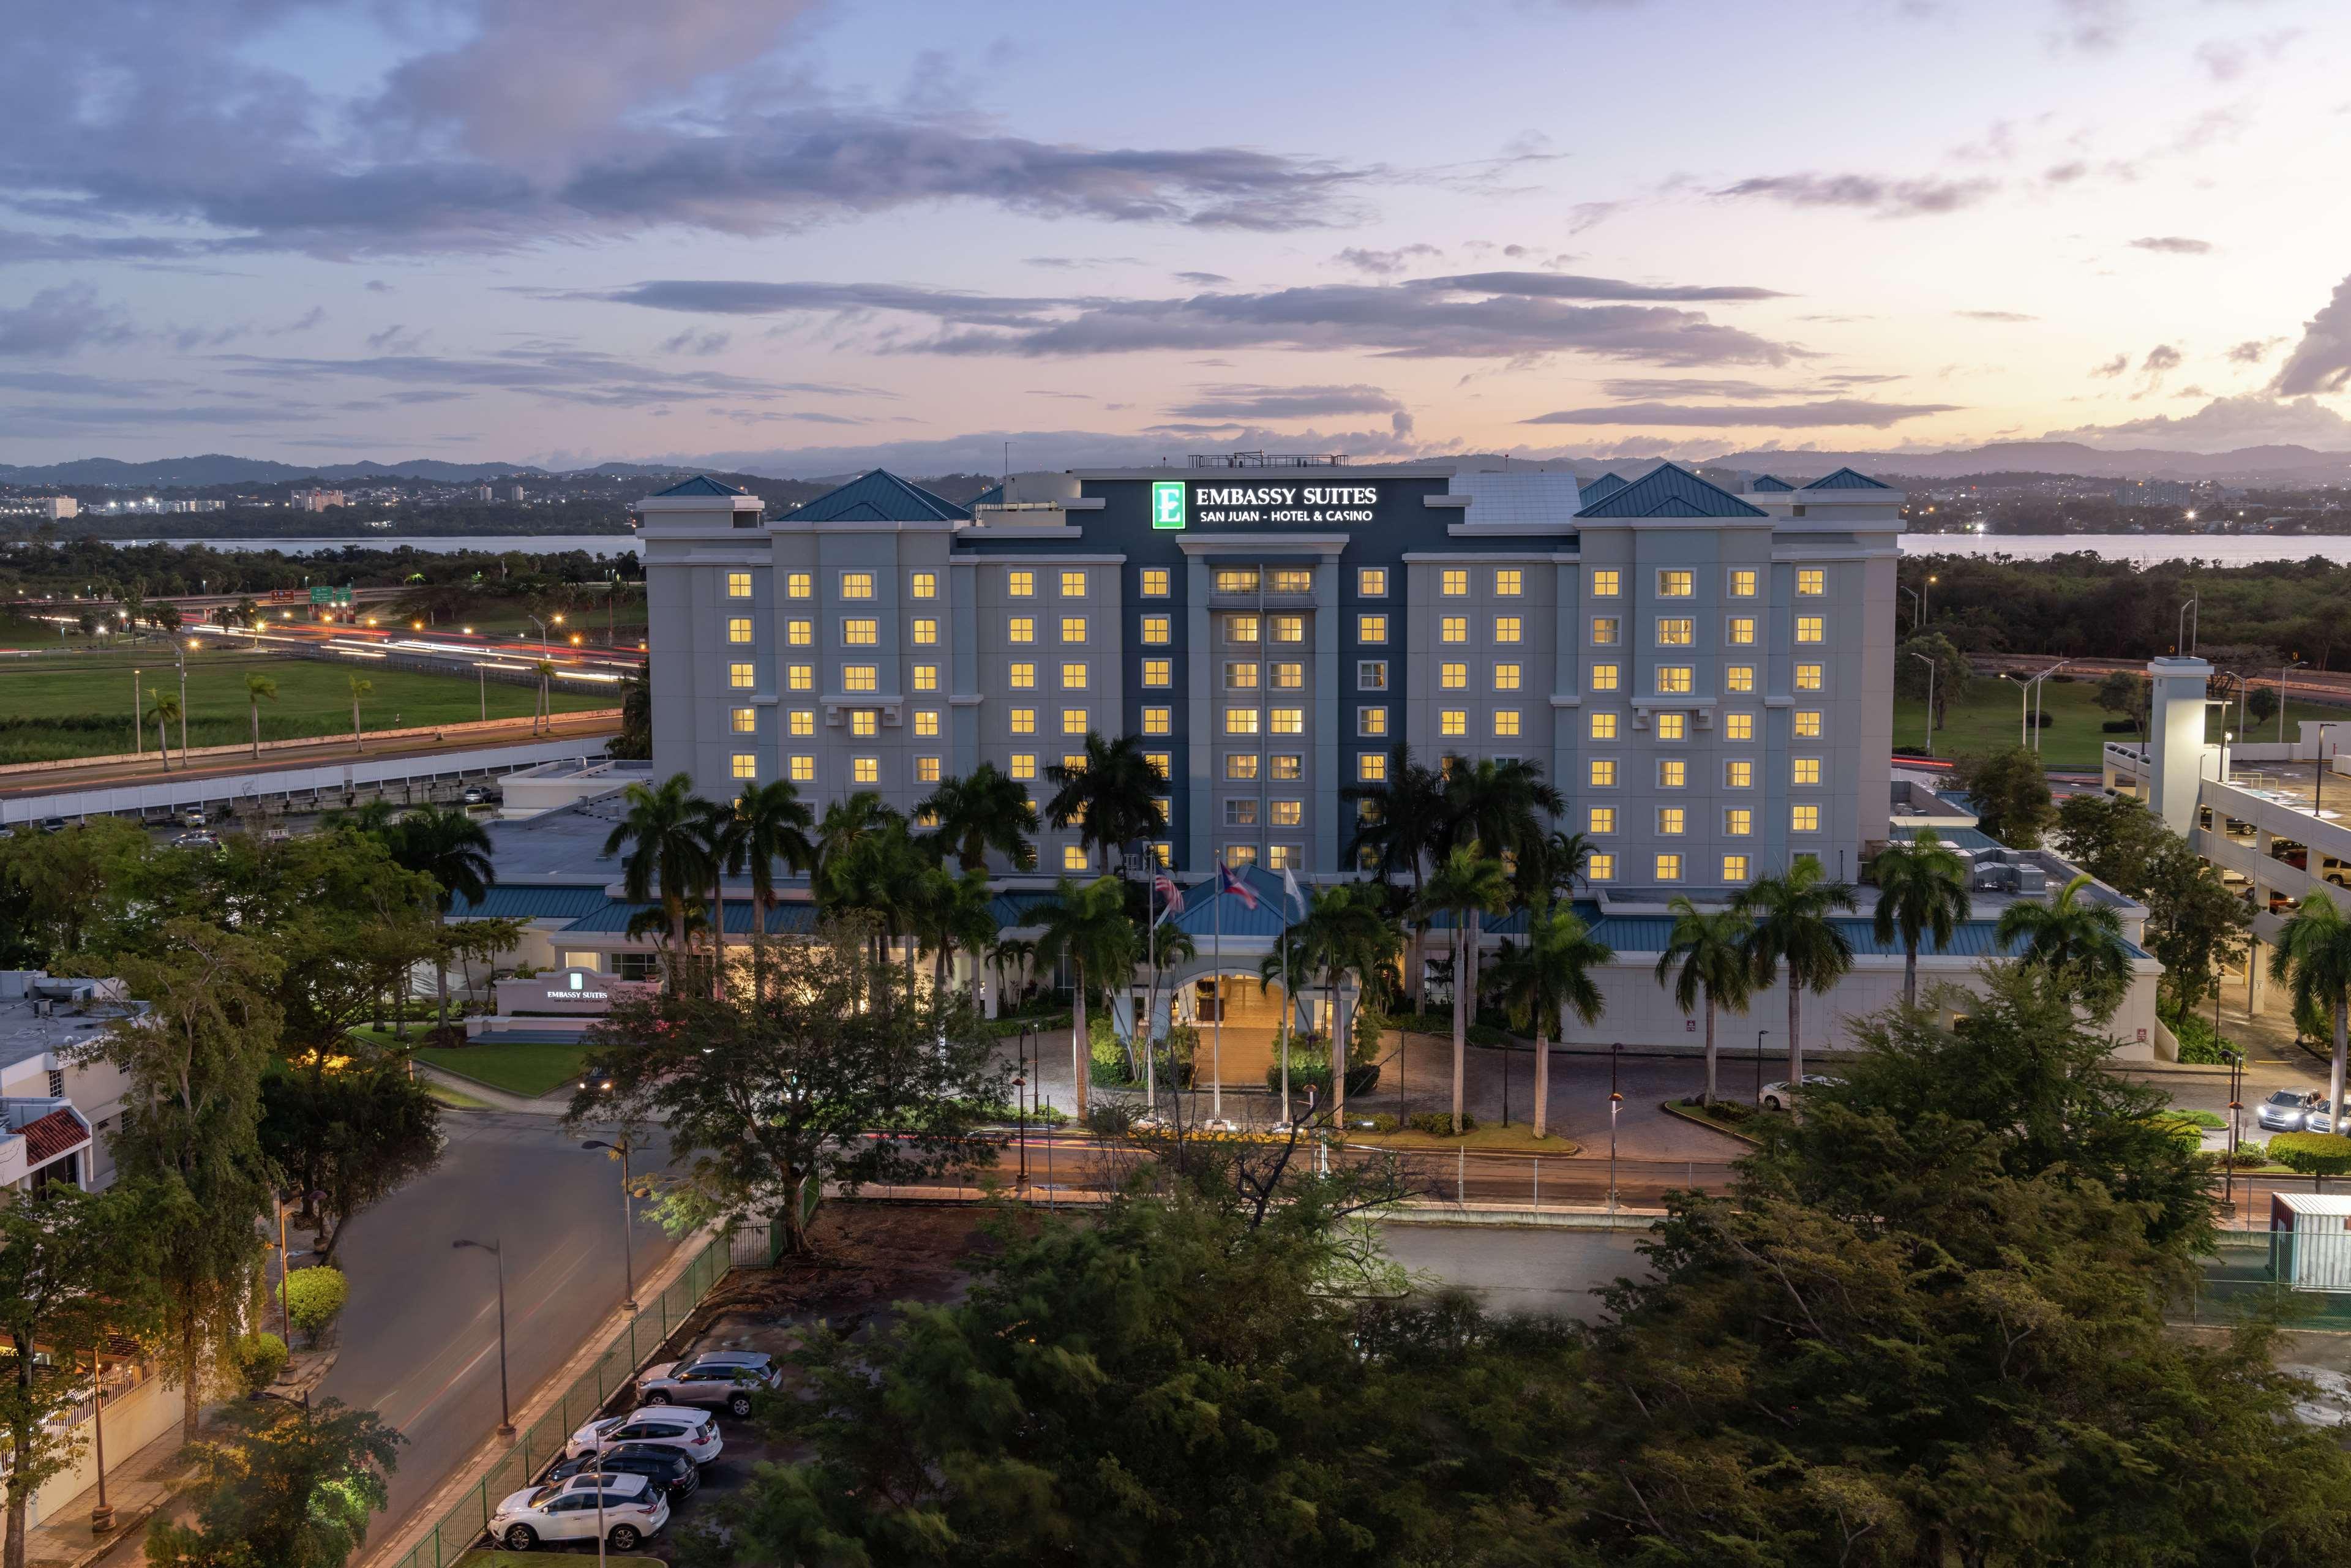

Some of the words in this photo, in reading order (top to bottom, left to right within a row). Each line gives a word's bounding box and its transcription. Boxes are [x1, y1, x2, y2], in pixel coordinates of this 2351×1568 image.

[1196, 488, 1296, 505] EMBASSY
[1303, 488, 1377, 505] SUITES
[1200, 511, 1224, 522] SAN
[1228, 511, 1259, 522] JUAN
[1271, 511, 1310, 521] HOTEL
[1313, 511, 1323, 522] &
[1325, 511, 1373, 521] CASINO
